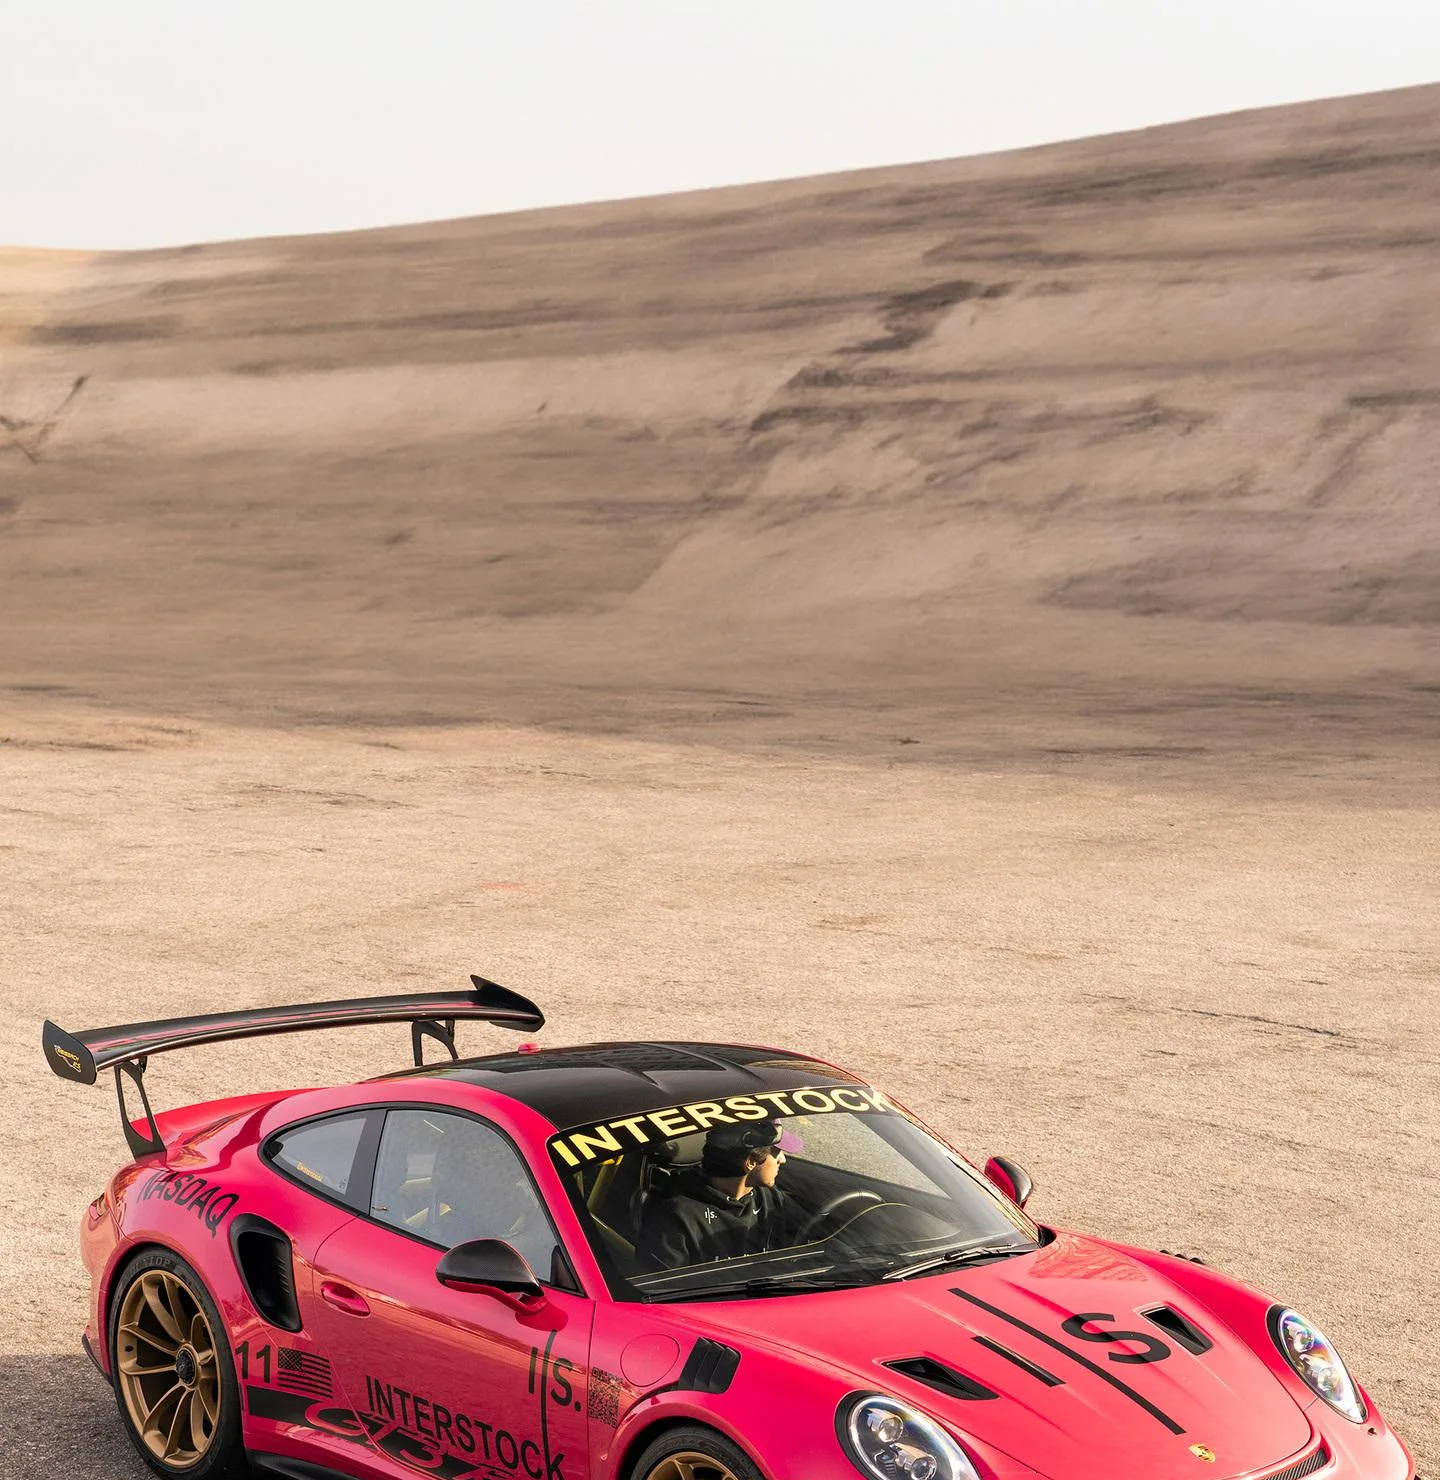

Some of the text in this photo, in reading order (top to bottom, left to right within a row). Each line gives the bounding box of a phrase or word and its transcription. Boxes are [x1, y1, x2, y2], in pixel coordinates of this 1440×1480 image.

[552, 1088, 887, 1167] INTERSTOCK
[136, 1168, 240, 1239] NASDAQ
[235, 1340, 273, 1384] 11
